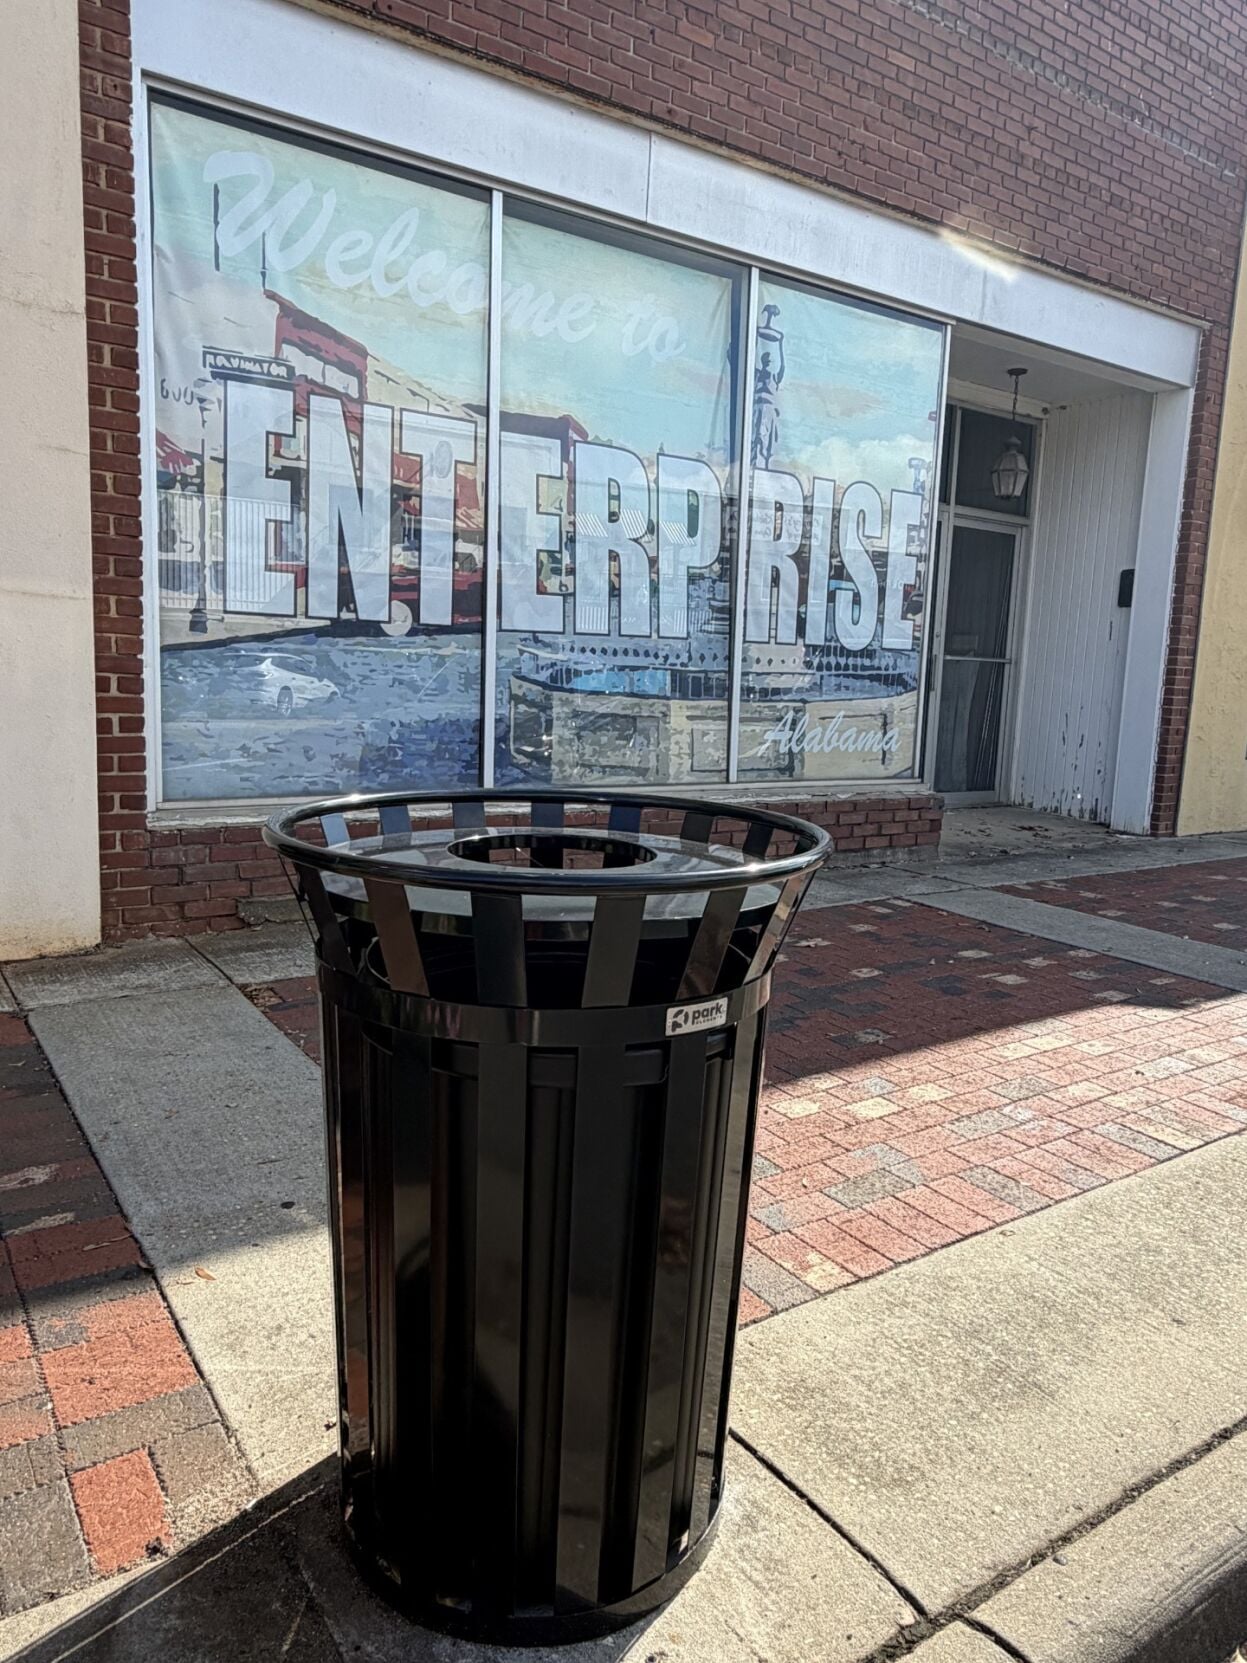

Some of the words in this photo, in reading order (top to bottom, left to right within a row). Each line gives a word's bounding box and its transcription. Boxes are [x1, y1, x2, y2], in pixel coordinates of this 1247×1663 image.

[203, 150, 596, 344] Welcome
[621, 302, 687, 363] to
[223, 379, 923, 651] ENTERPRISE
[757, 710, 902, 757] Alabama
[691, 1002, 723, 1026] park
